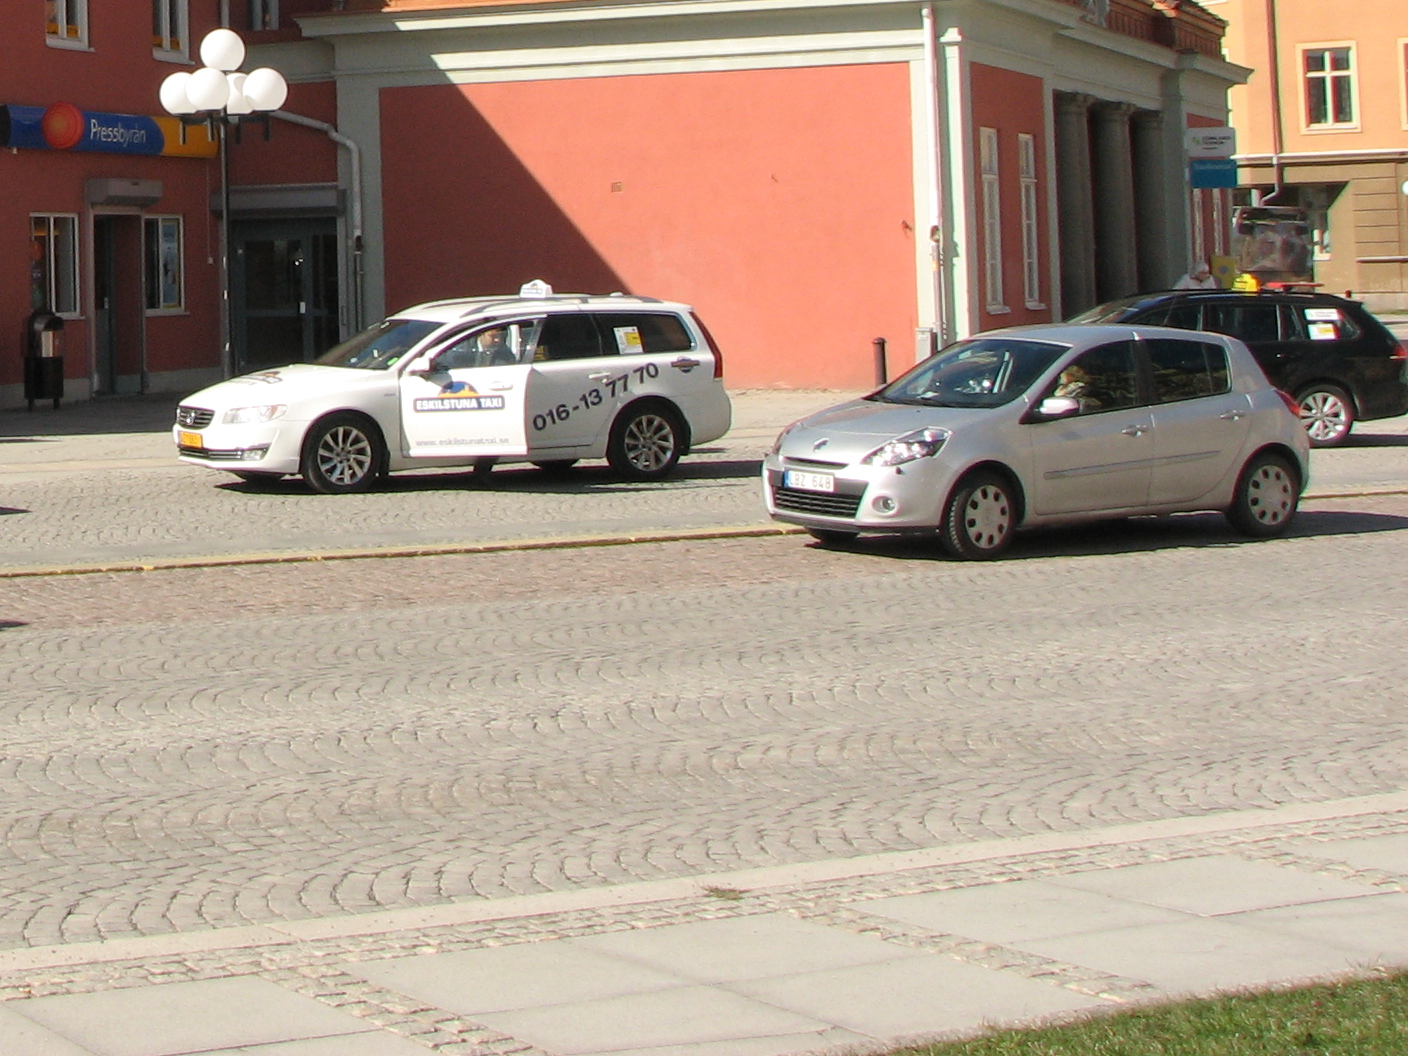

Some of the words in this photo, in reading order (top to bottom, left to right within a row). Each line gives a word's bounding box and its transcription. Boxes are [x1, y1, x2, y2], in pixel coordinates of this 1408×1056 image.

[90, 118, 146, 147] Pressbyrån
[416, 399, 478, 411] ESKILSTUNA
[479, 397, 503, 408] TAXI
[532, 388, 603, 431] 016-13
[605, 374, 630, 398] 77
[633, 363, 659, 384] 70
[789, 473, 806, 487] LBZ
